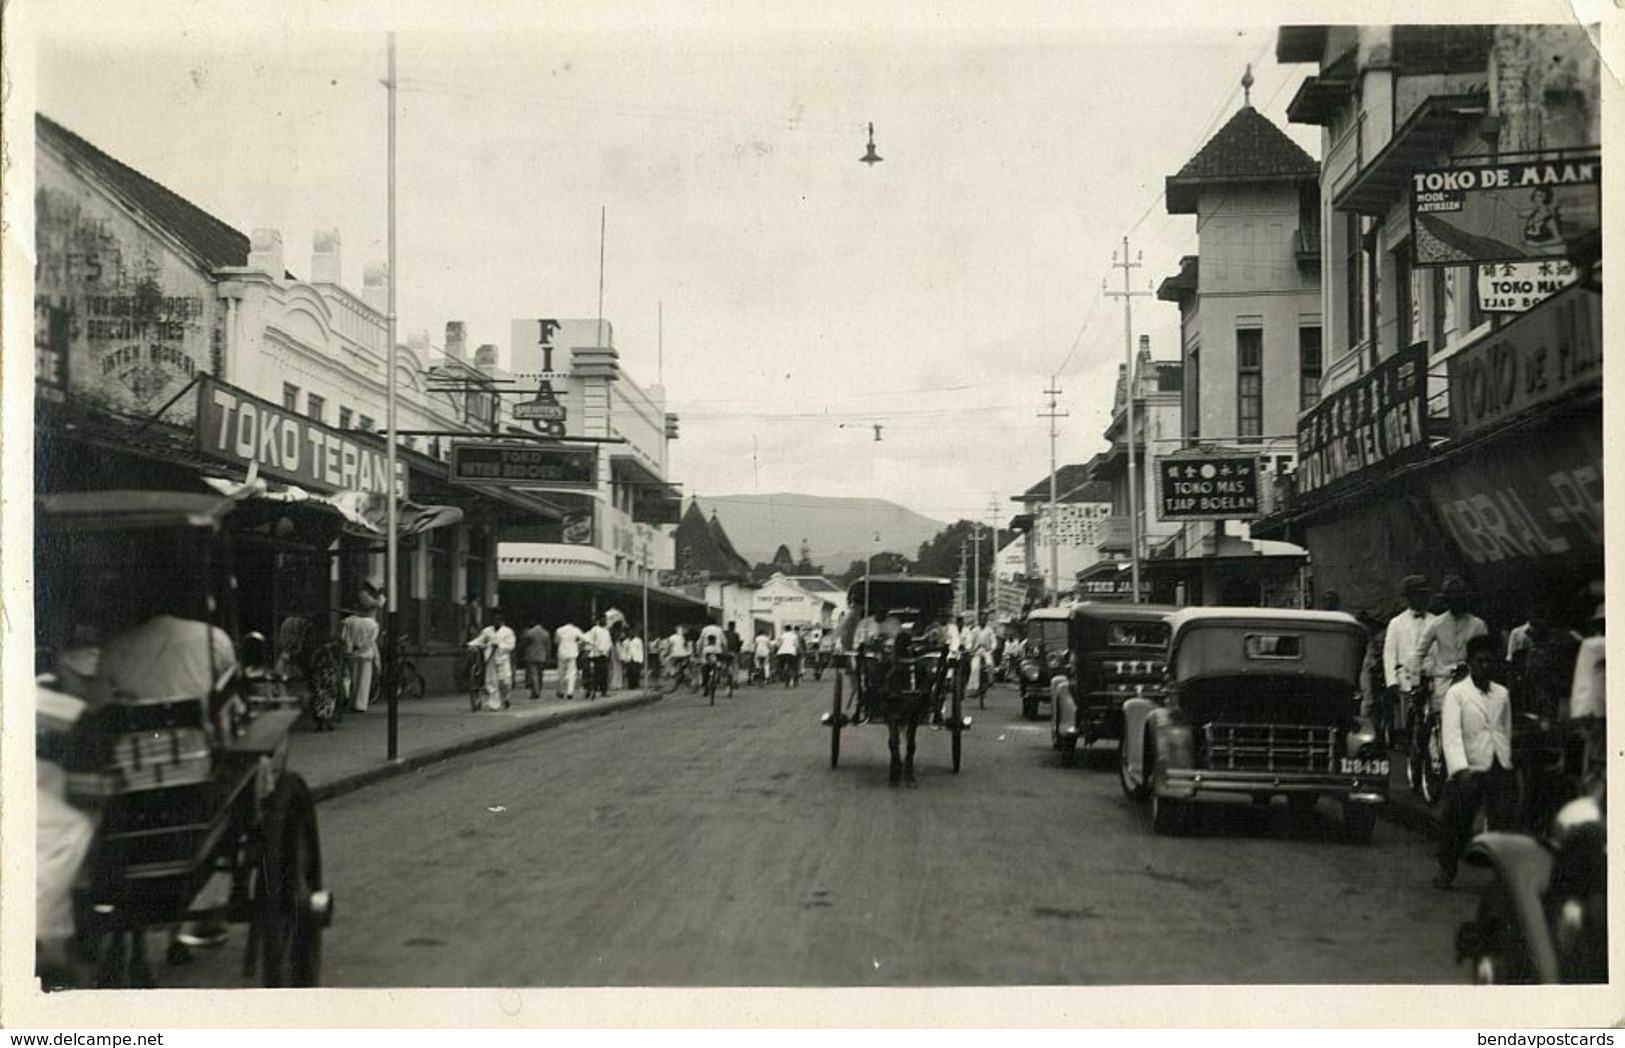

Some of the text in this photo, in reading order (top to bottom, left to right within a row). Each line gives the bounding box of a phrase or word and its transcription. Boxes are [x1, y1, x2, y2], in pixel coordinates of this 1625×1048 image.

[1413, 165, 1593, 191] TOKO DE MAAN
[1491, 280, 1533, 293] TOKO
[1483, 298, 1515, 307] TJAP
[213, 389, 300, 472] TOKO
[1173, 480, 1245, 494] TOKO MAS
[1165, 497, 1196, 510] TJAP
